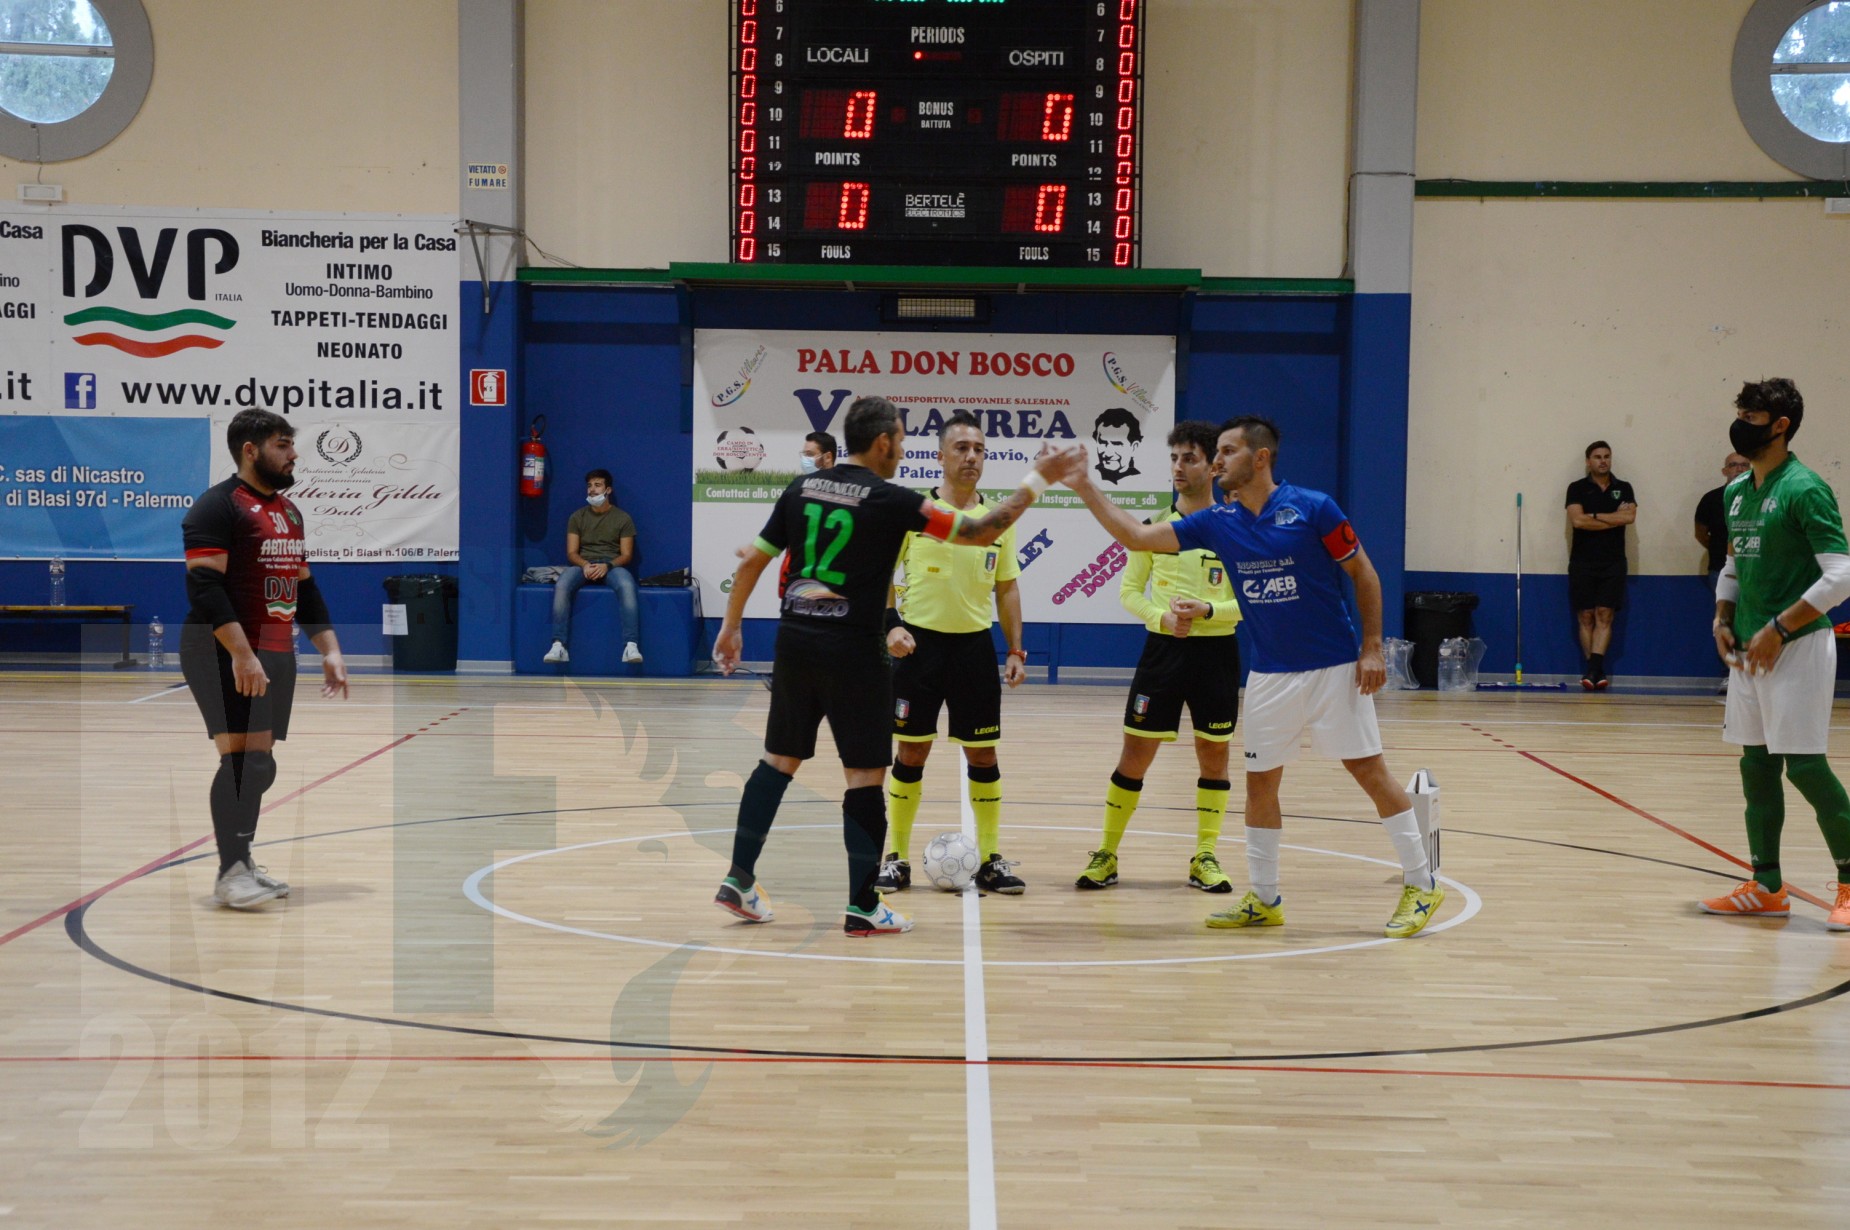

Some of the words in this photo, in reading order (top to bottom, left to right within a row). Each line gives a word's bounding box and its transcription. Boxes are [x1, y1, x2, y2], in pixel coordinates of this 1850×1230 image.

[1096, 2, 1105, 16] 6
[742, 21, 756, 43] 0
[776, 27, 783, 40] 7
[911, 27, 965, 44] PERIODS
[1097, 29, 1104, 42] 7
[1119, 25, 1134, 48] 0
[742, 48, 756, 70] 0
[775, 53, 783, 67] 8
[807, 47, 869, 63] LOCALI
[1009, 50, 1064, 66] OSPITI
[1096, 58, 1104, 71] 8
[1119, 52, 1133, 75] 0
[742, 75, 756, 97] 0
[775, 81, 782, 94] 9
[1095, 84, 1104, 98] 9
[1118, 80, 1133, 103] 0
[741, 103, 755, 125] 0
[769, 108, 782, 121] 10
[843, 91, 876, 138] 0
[919, 101, 954, 116] BONUS
[1089, 113, 1103, 126] 10
[1117, 107, 1132, 130] 0
[921, 119, 951, 129] BATTUTA
[741, 130, 755, 152] 0
[769, 136, 780, 149] 11
[1089, 140, 1103, 153] 11
[1117, 134, 1132, 157] 0
[469, 165, 496, 174] VIETATO
[815, 152, 860, 166] POINTS
[1011, 154, 1057, 167] POINTS
[469, 178, 506, 187] FUMARE
[740, 185, 754, 206] 0
[768, 189, 781, 203] 13
[838, 182, 869, 230] 0
[1088, 193, 1102, 206] 13
[1116, 188, 1131, 211] 0
[1034, 185, 1066, 231] 0
[0, 221, 43, 239] Casa
[740, 211, 754, 233] 0
[768, 216, 780, 230] 14
[1087, 220, 1101, 234] 14
[1115, 216, 1130, 238] 0
[261, 230, 353, 249] Biancheria
[360, 235, 388, 253] per
[393, 233, 408, 250] la
[414, 233, 456, 251] Casa
[740, 238, 754, 260] 0
[767, 243, 780, 257] 15
[821, 245, 851, 259] FOULS
[62, 224, 240, 301] DVP
[1019, 246, 1049, 260] FOULS
[1086, 248, 1101, 261] 15
[1115, 243, 1130, 265] 0
[326, 263, 393, 280] INTIMO
[215, 293, 243, 302] ITALIA
[285, 282, 434, 299] Uomo-Donna-Bambino
[271, 310, 448, 330] TAPPETI-TENDAGGI
[317, 342, 403, 360] NEONATO
[797, 349, 880, 374] PALA
[890, 350, 960, 375] DON
[969, 351, 1075, 377] BOSCO
[121, 377, 443, 414] www.dvpitalia.it
[886, 396, 956, 404] POLISPORTIVA
[959, 397, 1011, 405] GIOVANILE
[1015, 398, 1070, 406] SALESIANA
[15, 469, 46, 482] sas
[51, 466, 67, 483] di
[73, 466, 144, 483] Nicastro
[6, 489, 21, 506] di
[28, 489, 70, 507] Blasi
[75, 490, 106, 507] 97d
[123, 490, 194, 508] Palermo
[365, 484, 443, 510] Gilda
[706, 487, 750, 499] Contattaci
[752, 487, 769, 499] allo
[268, 511, 289, 534] 30
[343, 546, 353, 557] Di
[357, 548, 382, 557] Blasi
[385, 547, 423, 557] n.106/B
[801, 502, 854, 586] 12
[974, 725, 999, 735] LEGEA
[1209, 721, 1232, 729] LEGEA
